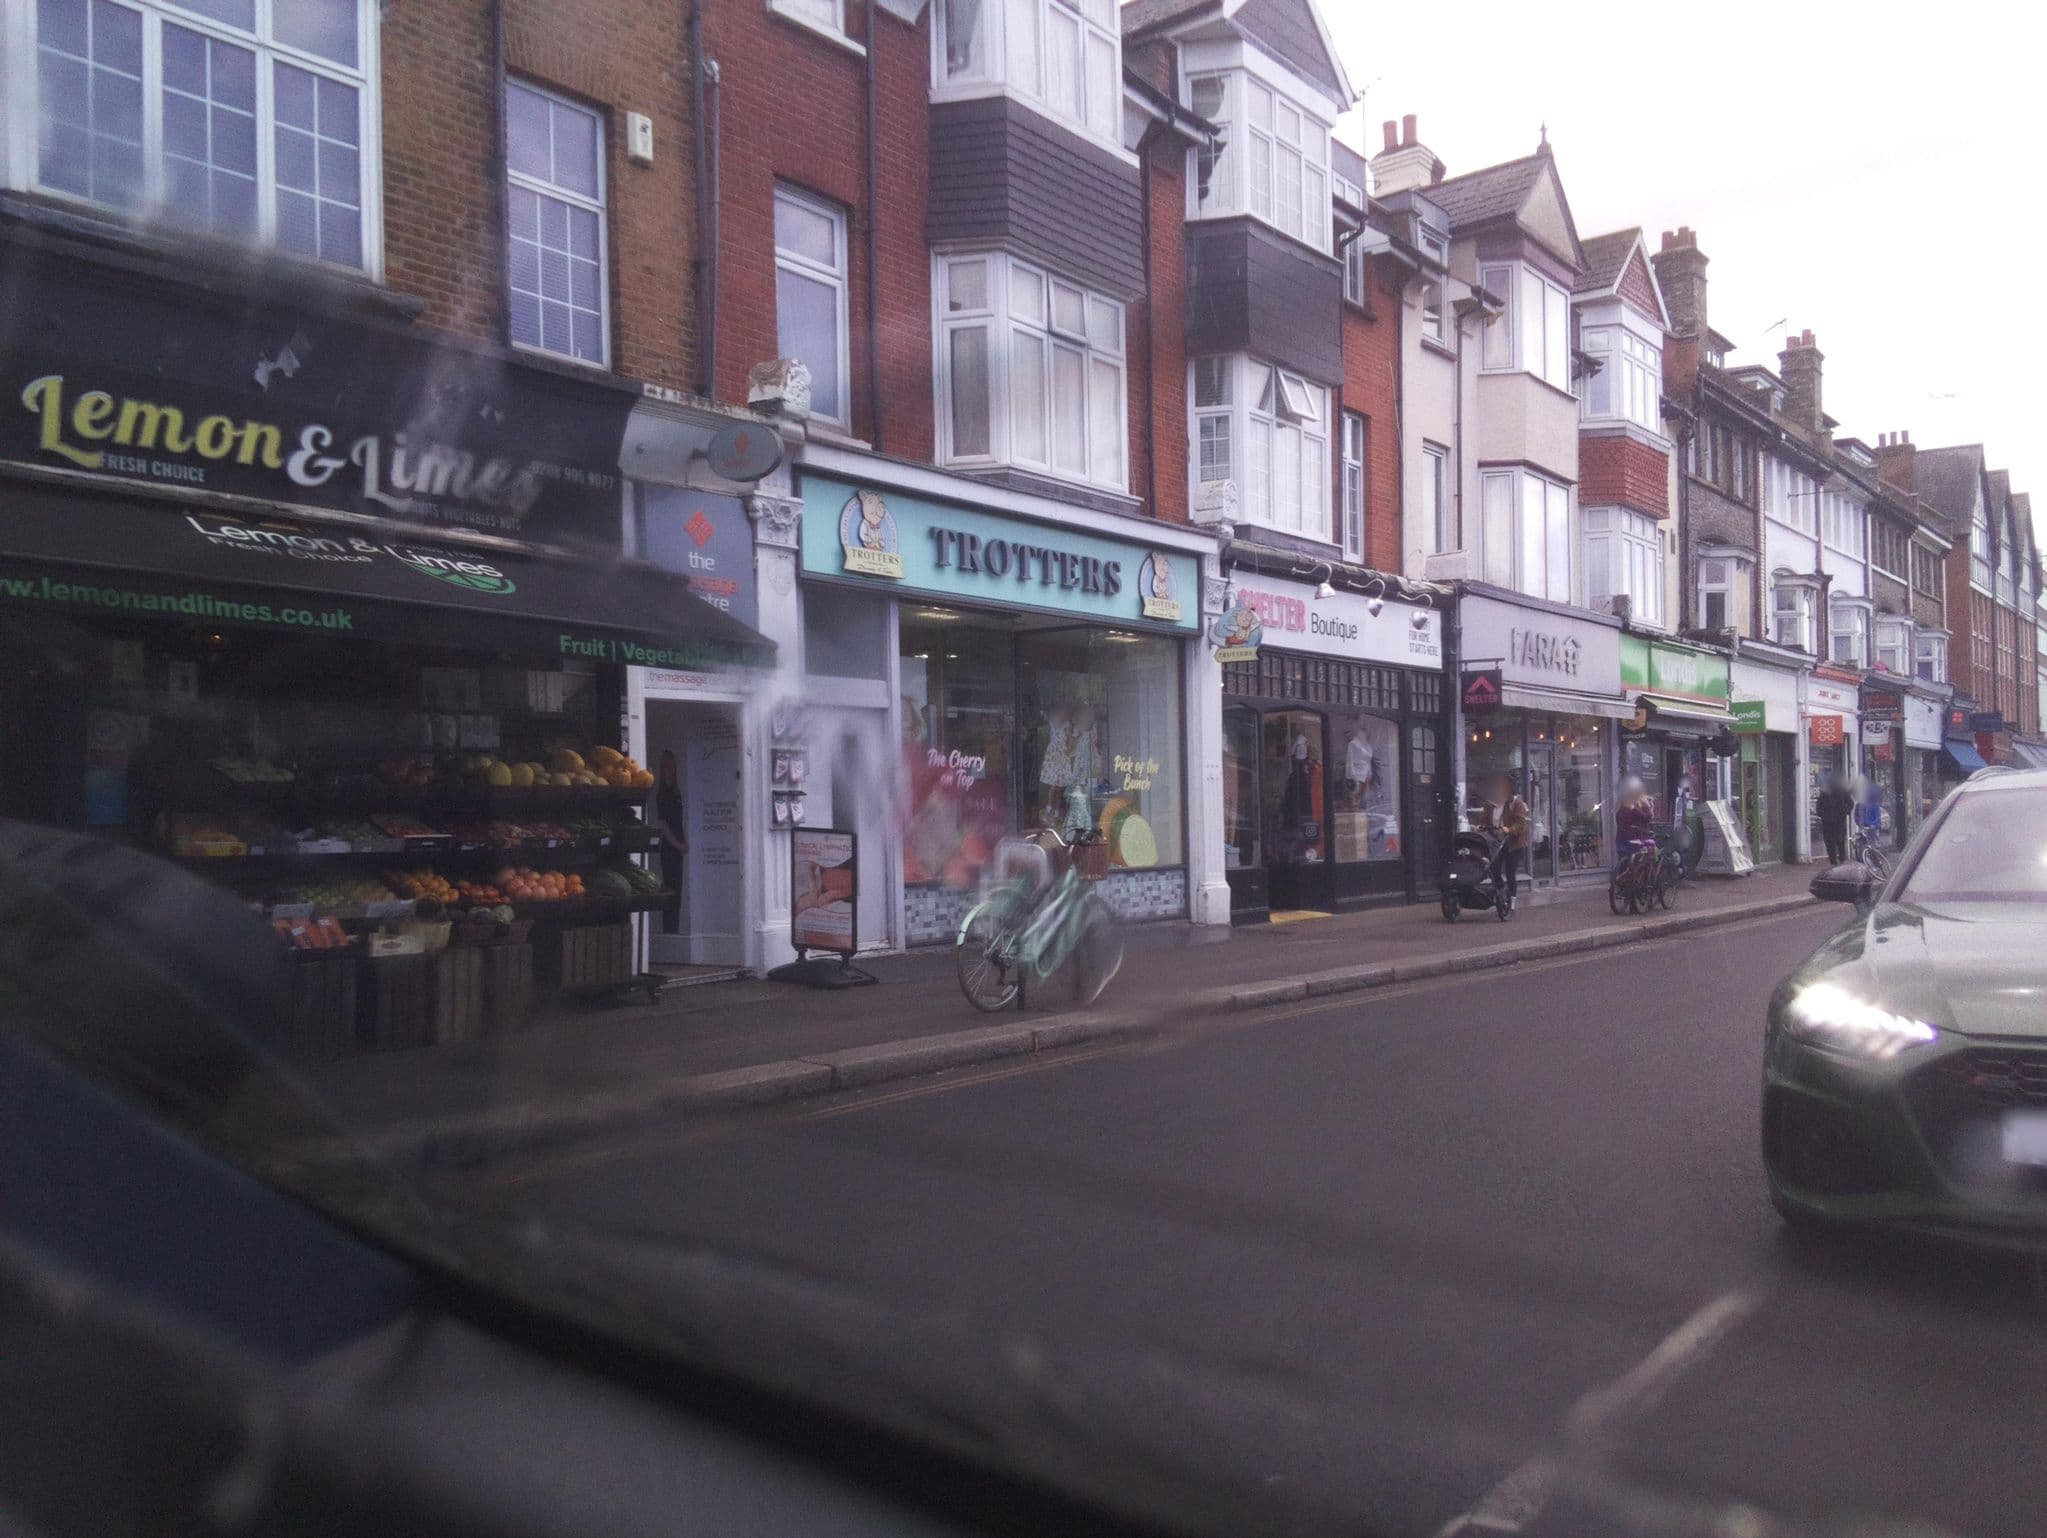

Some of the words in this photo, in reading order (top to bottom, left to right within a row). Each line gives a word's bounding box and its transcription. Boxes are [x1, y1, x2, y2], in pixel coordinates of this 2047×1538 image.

[22, 375, 283, 469] Lemon
[287, 424, 347, 486] &
[351, 436, 541, 514] Lime
[102, 452, 147, 475] FRESH
[151, 460, 205, 482] CHOICE
[185, 516, 346, 552] Lemon
[347, 537, 382, 554] &
[384, 545, 504, 577] Limes
[207, 536, 283, 556] Fresh
[288, 548, 373, 563] Choice
[851, 548, 899, 566] TROTTERS
[688, 551, 716, 571] the
[929, 526, 1123, 596] TROTTERS
[1311, 612, 1358, 642] Boutique
[560, 635, 606, 657] Fruit
[622, 642, 712, 666] Vegetab
[927, 748, 947, 768] The
[949, 749, 986, 773] Cherry
[1113, 754, 1133, 774] Pick
[956, 768, 975, 792] Top
[1123, 773, 1151, 791] Bunch
